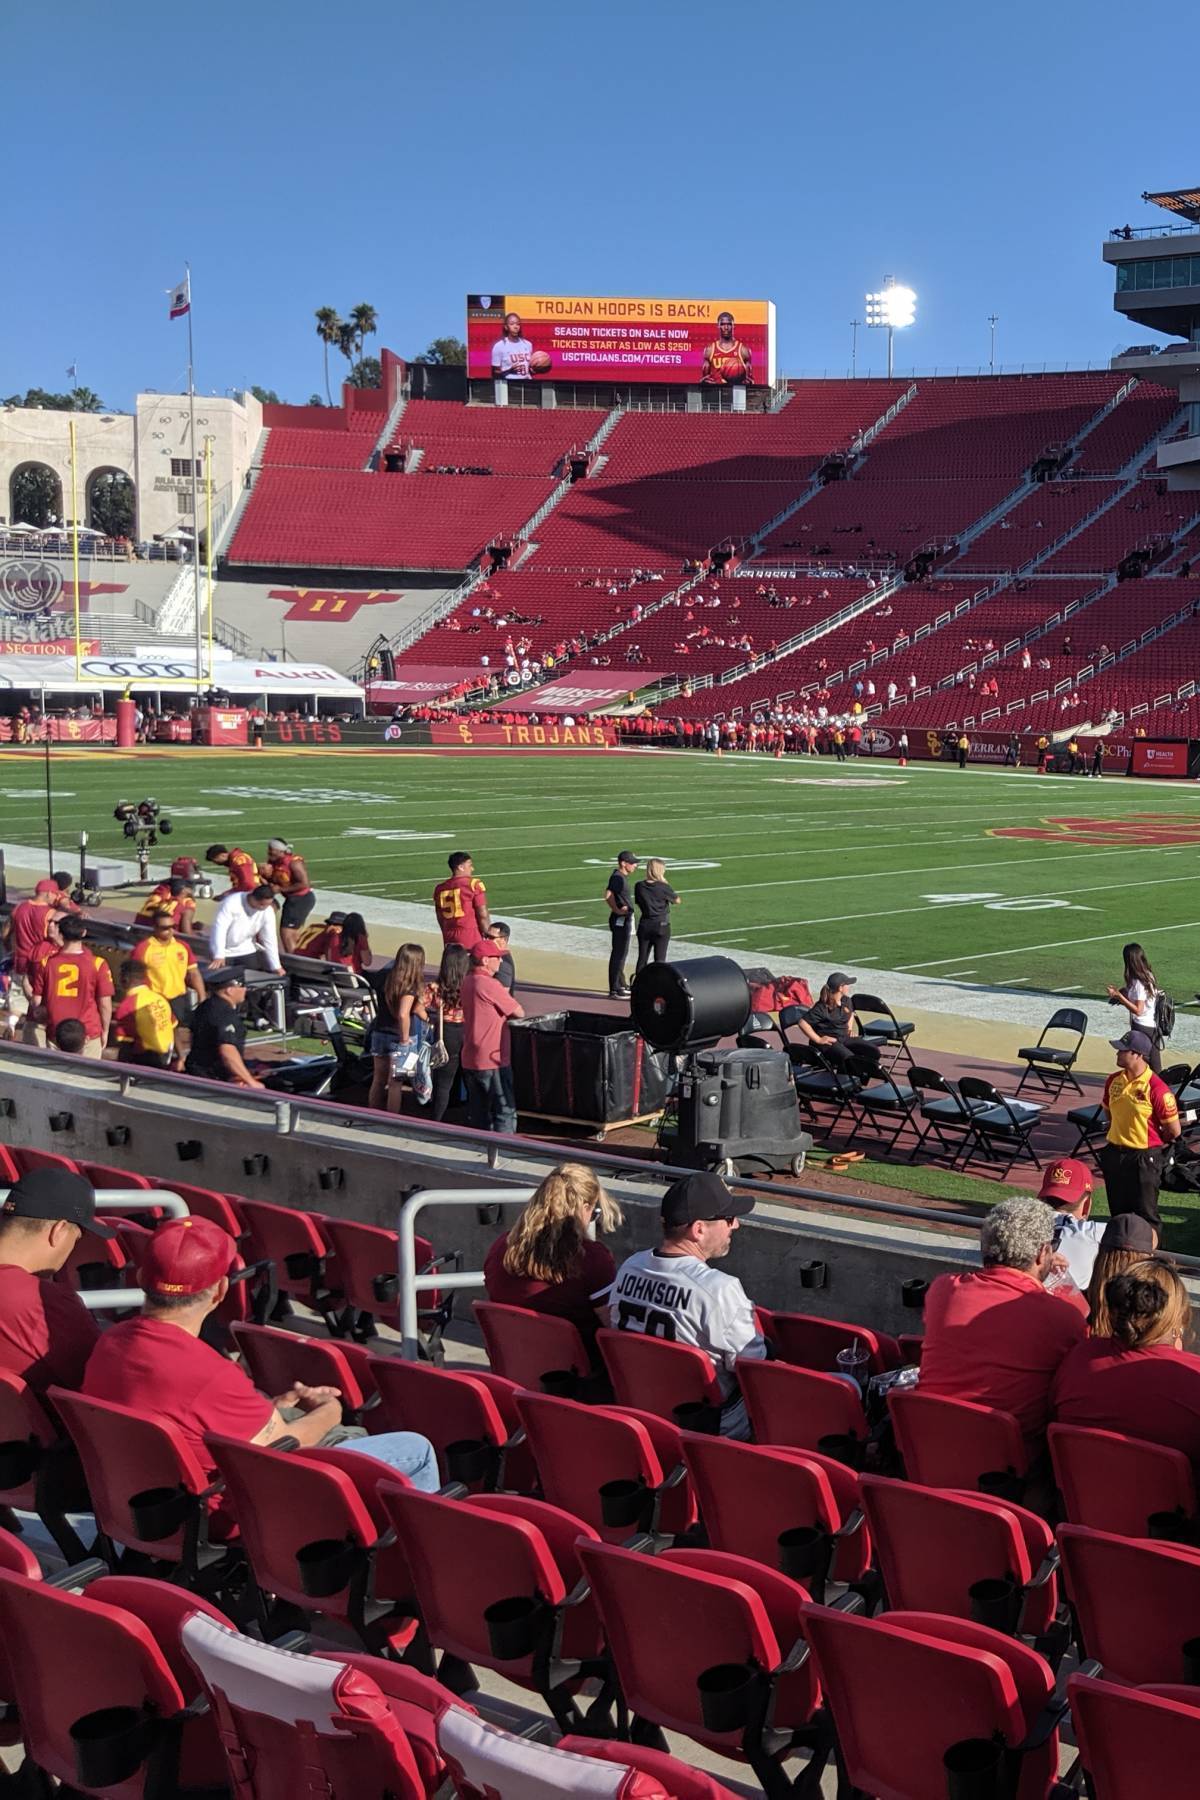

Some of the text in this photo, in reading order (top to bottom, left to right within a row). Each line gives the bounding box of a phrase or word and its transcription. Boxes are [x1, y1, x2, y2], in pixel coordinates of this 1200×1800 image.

[536, 301, 710, 318] TROJAN HOOPS IS BACK!
[554, 327, 688, 339] SEASON TICKETS ON SALE NOW
[552, 340, 692, 352] TICKETS START AS LOW AS $250!
[562, 352, 682, 364] USCTROJANS.COM/TICKETS
[6, 642, 66, 656] SECTION
[254, 668, 337, 681] Audi
[536, 687, 629, 699] MUSCLE
[279, 722, 342, 742] UTES
[502, 725, 605, 744] TROJANS
[440, 888, 465, 920] 51
[57, 964, 80, 998] 2
[164, 1284, 184, 1292] USC
[616, 1272, 692, 1310] JOHNSON
